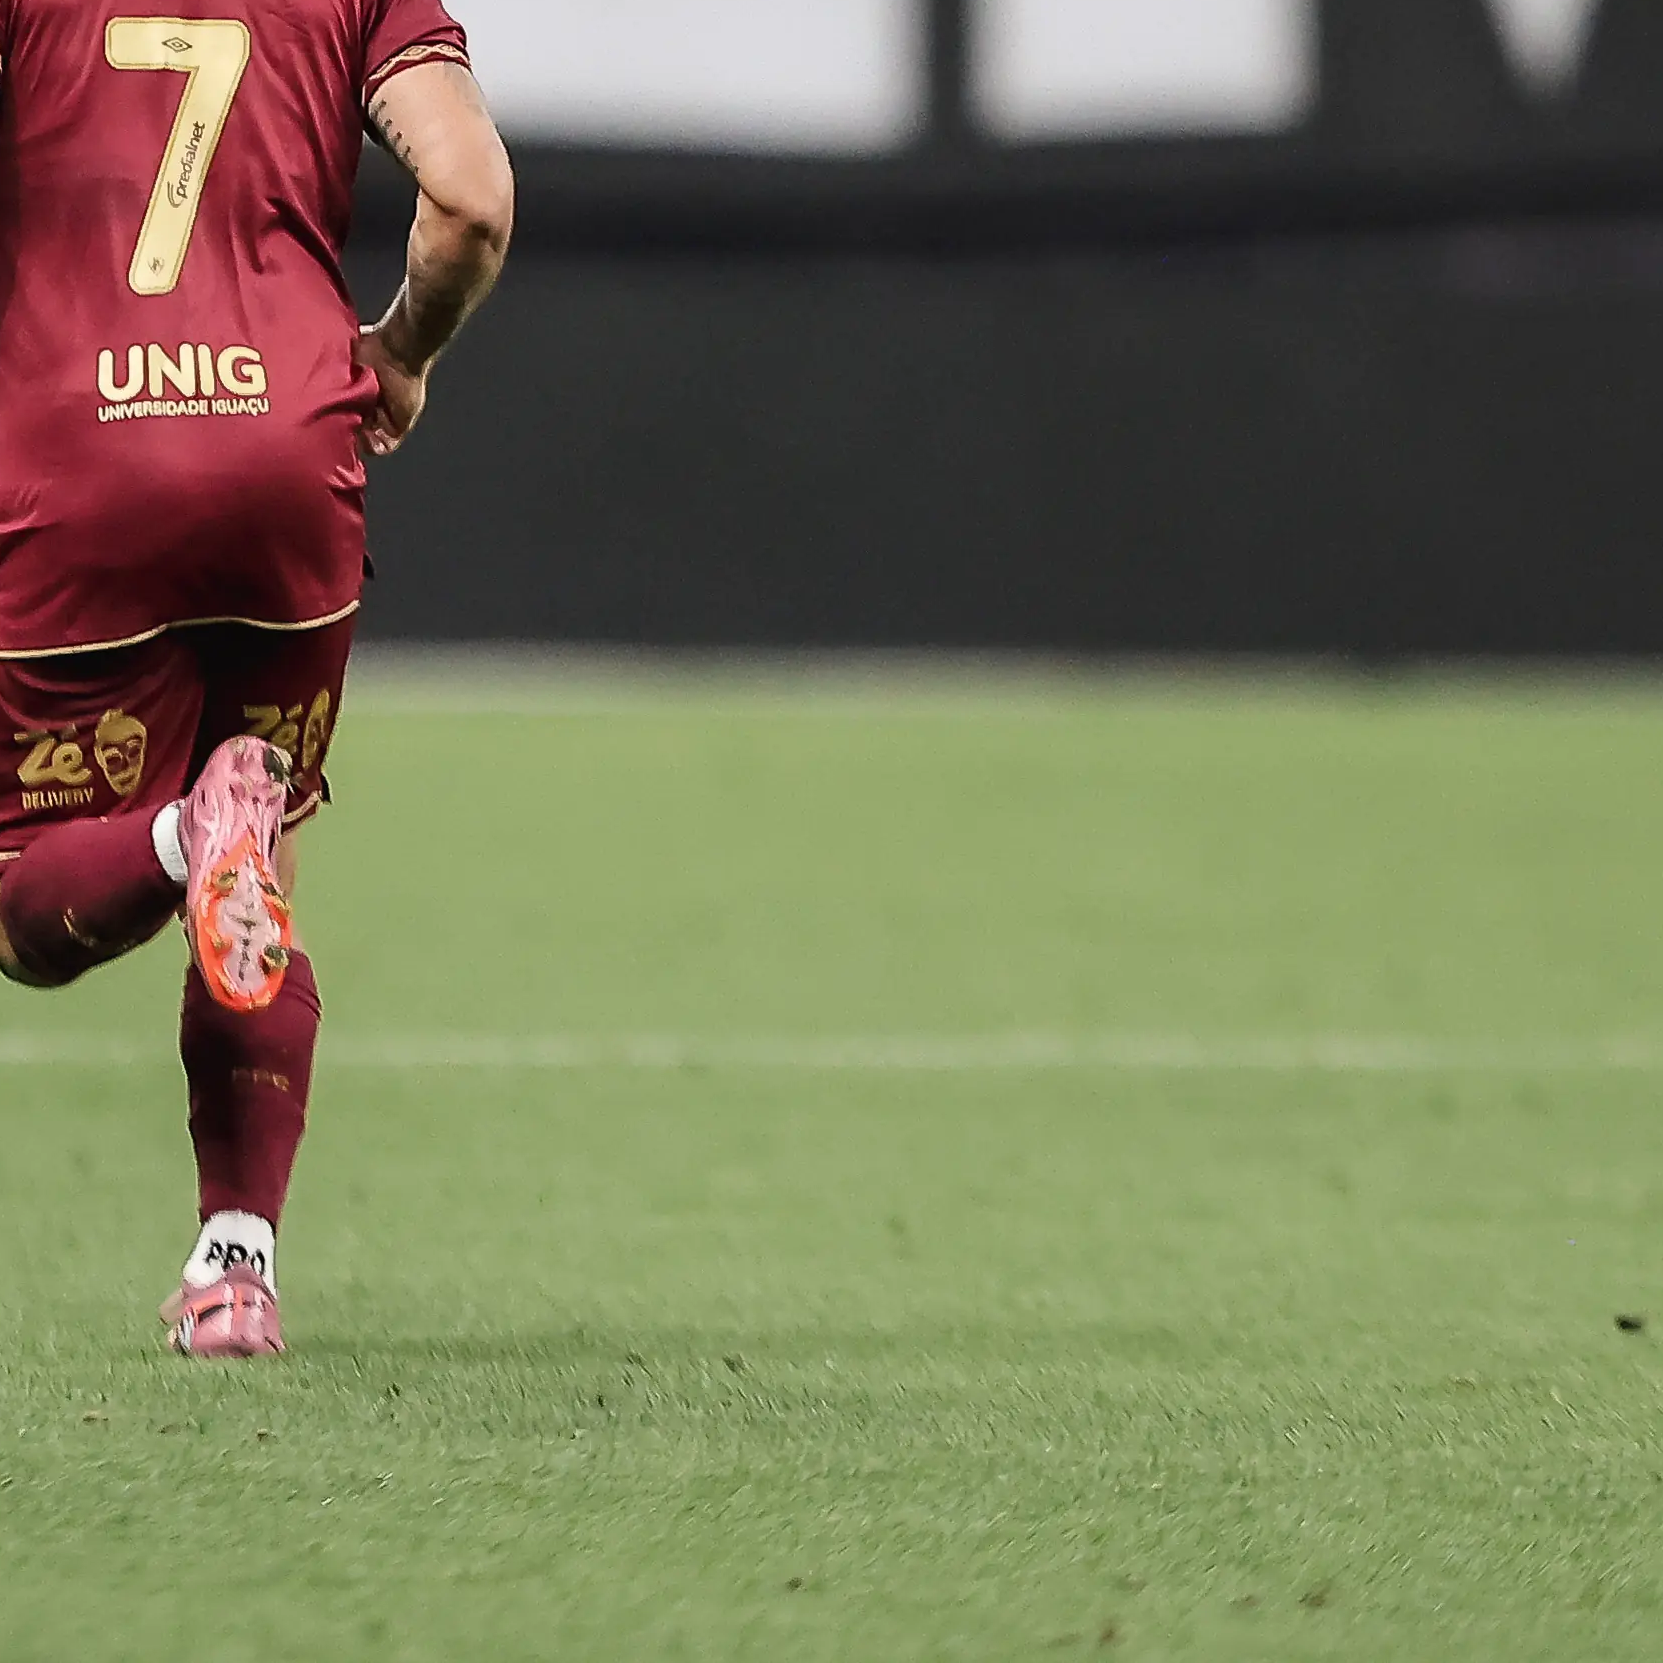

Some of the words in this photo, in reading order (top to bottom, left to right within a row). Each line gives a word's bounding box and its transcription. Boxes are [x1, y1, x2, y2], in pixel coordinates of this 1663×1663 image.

[104, 16, 252, 296] 7
[175, 120, 206, 200] predialnet
[97, 342, 268, 402] UNIG
[97, 398, 209, 423] UNIVERSIDADE
[211, 397, 270, 417] IGUAÇU
